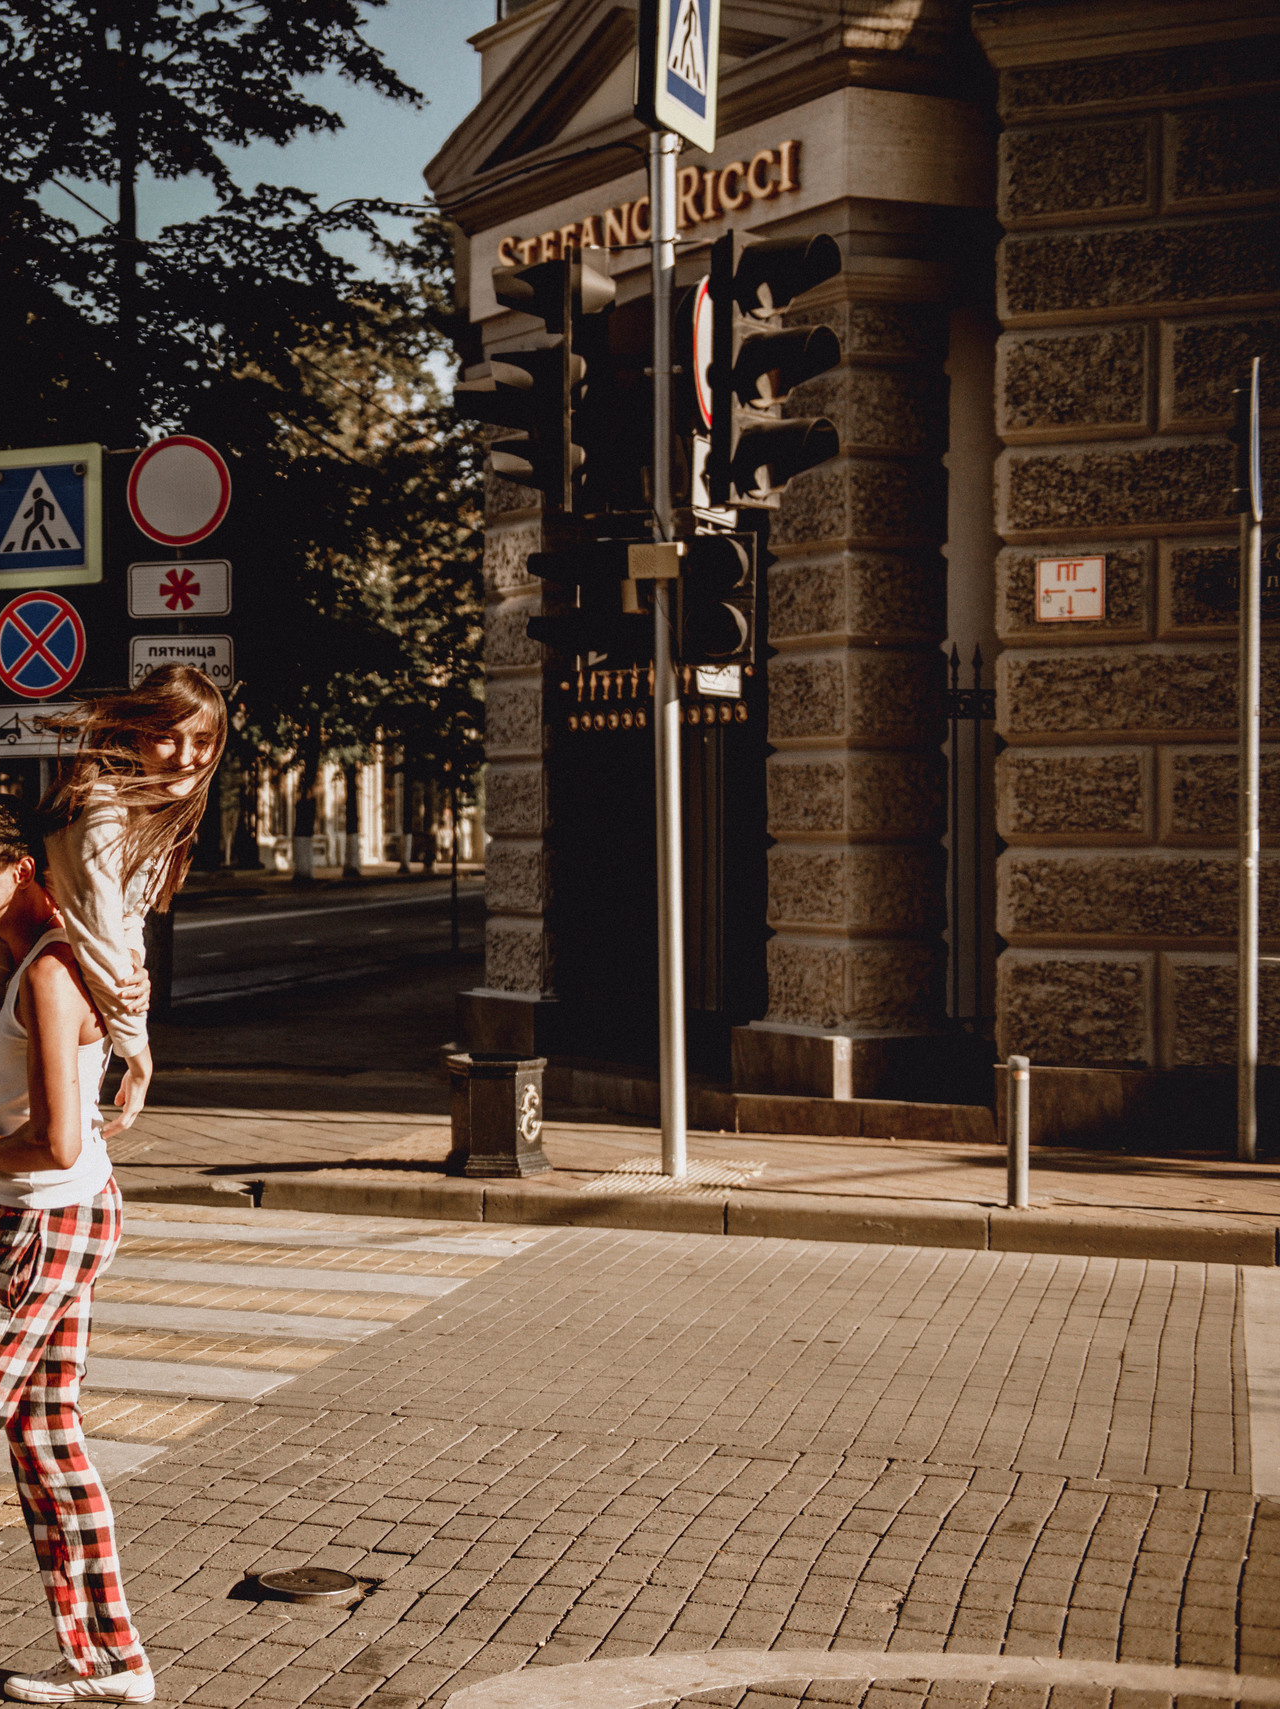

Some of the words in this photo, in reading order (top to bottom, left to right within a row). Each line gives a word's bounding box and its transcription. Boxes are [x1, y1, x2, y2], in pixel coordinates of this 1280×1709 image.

[676, 138, 798, 230] RICCI
[1057, 563, 1084, 581] ПГ
[148, 646, 216, 659] пятница
